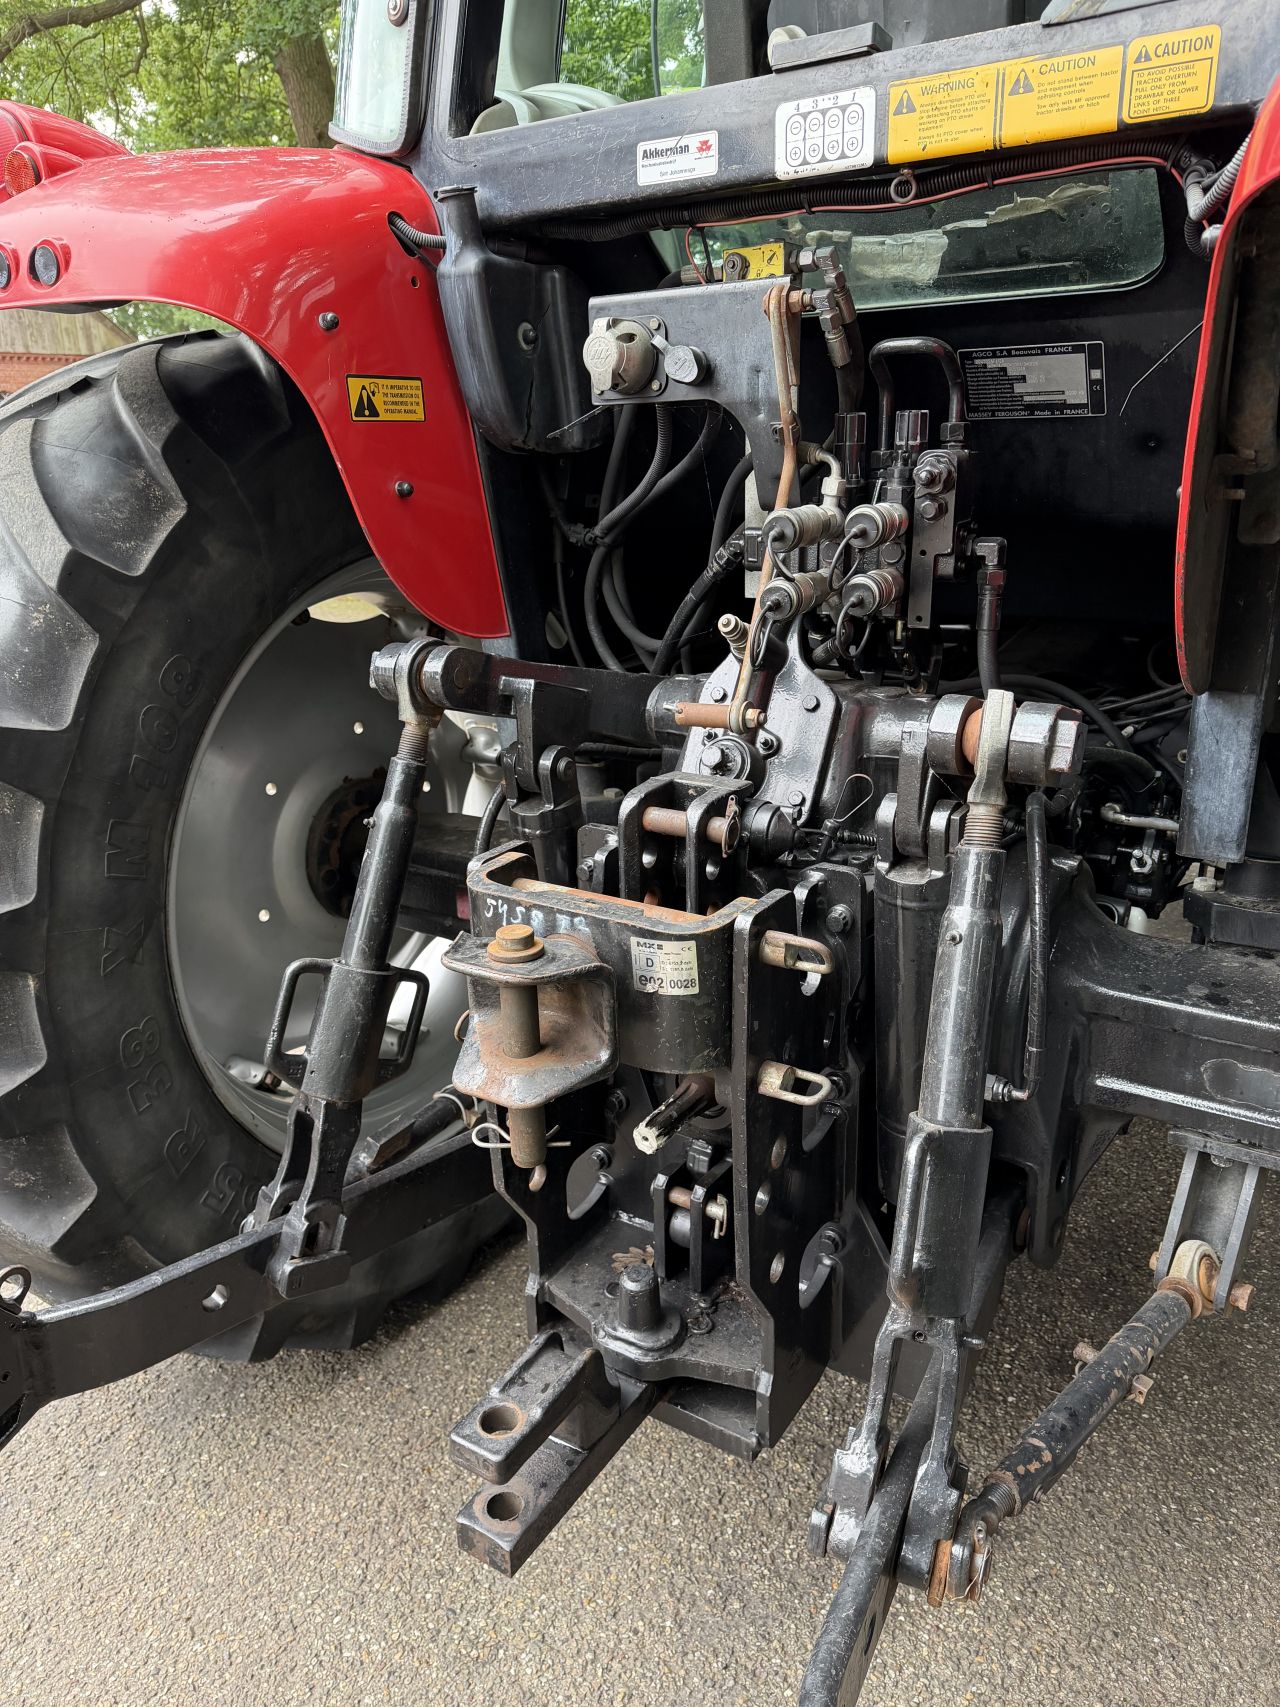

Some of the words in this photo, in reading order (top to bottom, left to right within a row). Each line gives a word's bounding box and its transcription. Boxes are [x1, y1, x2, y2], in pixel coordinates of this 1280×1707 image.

[1155, 34, 1213, 58] CAUTION
[1039, 56, 1096, 75] CAUTION
[1169, 64, 1195, 73] POSSIBLE
[1075, 73, 1098, 81] between
[1137, 77, 1162, 85] TRACTOR
[1165, 71, 1197, 80] OVERTURN
[921, 78, 974, 96] WARNING
[1050, 83, 1076, 92] equipment
[1085, 93, 1110, 102] approved
[1135, 92, 1163, 101] DRAWBAR
[794, 102, 800, 112] 4
[812, 99, 818, 109] 3
[832, 95, 839, 105] 2
[851, 92, 856, 102] 1
[642, 144, 689, 160] Akkerman
[637, 941, 655, 949] MX
[646, 958, 654, 967] D
[670, 978, 696, 989] 0028
